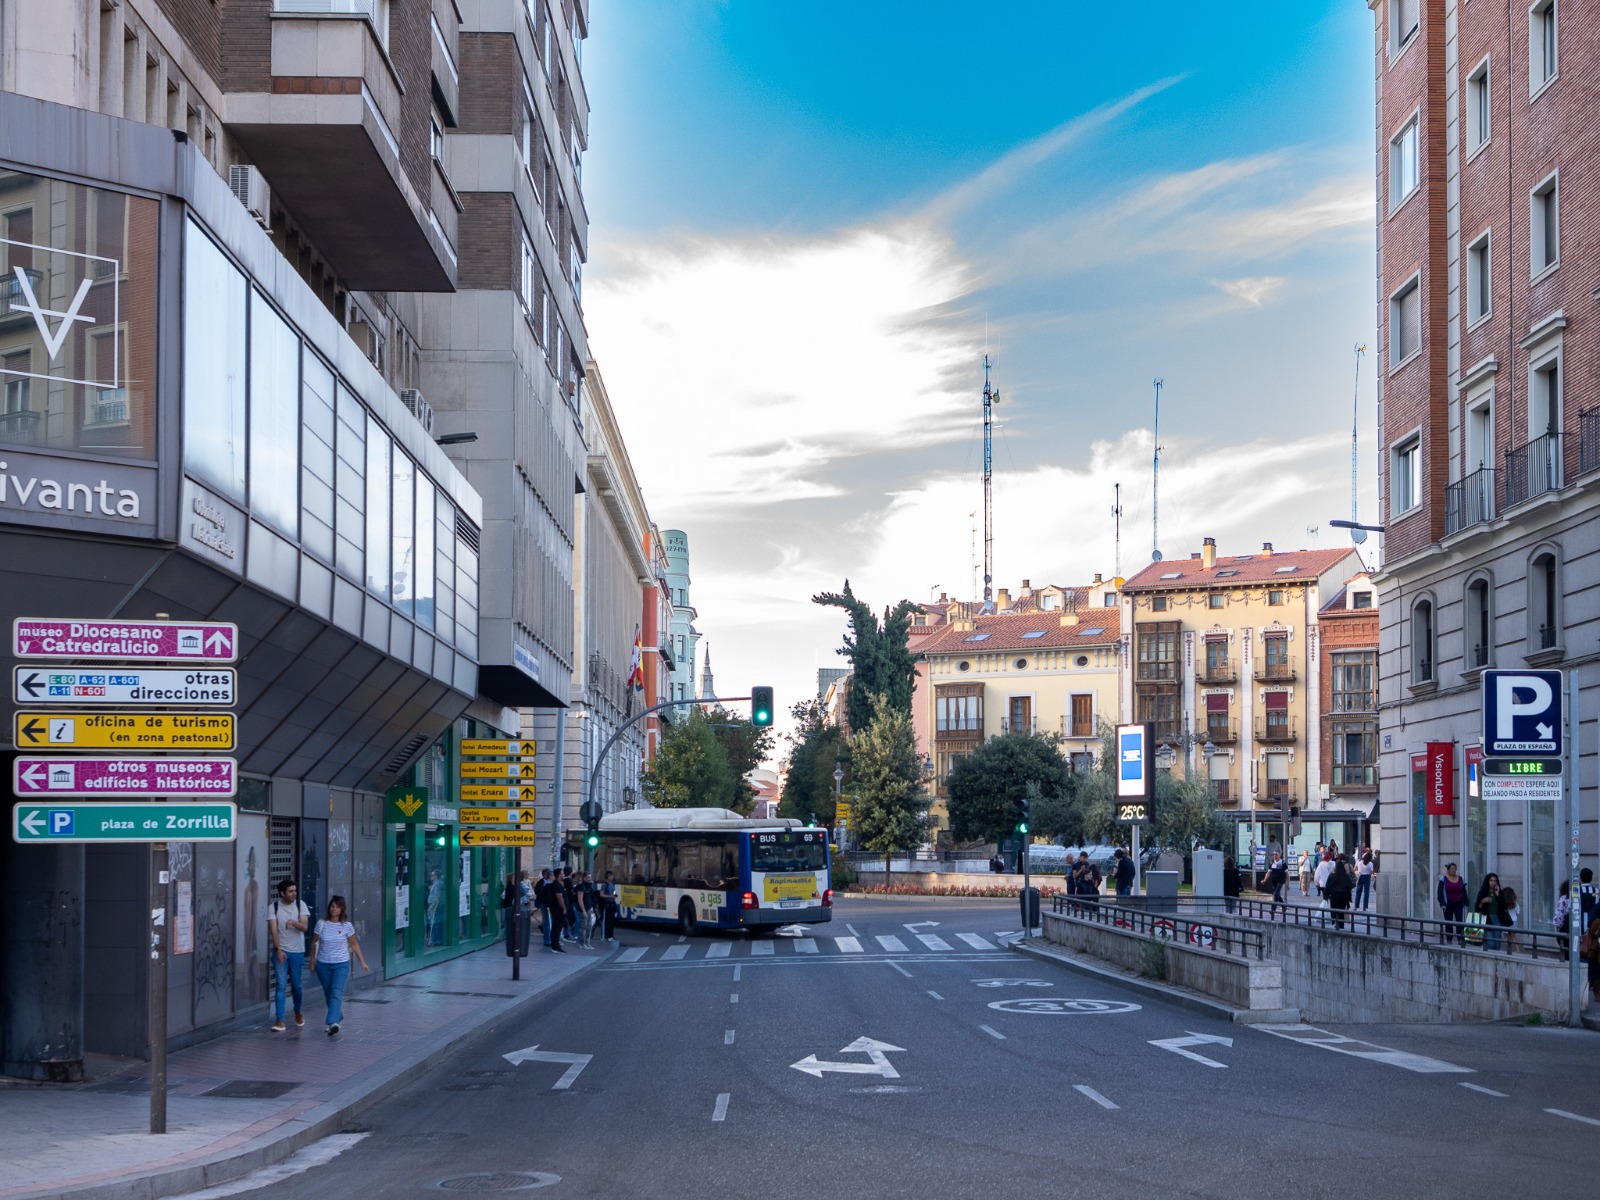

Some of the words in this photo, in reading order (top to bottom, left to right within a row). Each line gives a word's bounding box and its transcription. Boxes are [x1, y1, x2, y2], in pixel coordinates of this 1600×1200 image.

[20, 628, 63, 637] museo
[70, 624, 163, 639] Diocesano
[20, 640, 31, 653] y
[42, 638, 159, 654] Catredralicio
[49, 675, 75, 684] E-80
[80, 676, 105, 684] A-62
[110, 676, 139, 684] A-601
[185, 672, 230, 685] otras
[50, 687, 70, 695] A-11
[75, 687, 105, 695] N-601
[130, 686, 230, 700] direcciones
[1496, 675, 1553, 739] P
[85, 716, 135, 727] oficina
[145, 717, 163, 728] de
[172, 717, 229, 728] turismo
[109, 731, 130, 743] (en
[137, 733, 164, 742] zona
[172, 732, 229, 744] peatonal)
[108, 761, 147, 773] otros
[155, 762, 212, 773] museos
[221, 763, 230, 775] y
[1509, 763, 1543, 773] LIBRE
[157, 776, 230, 789] históricos
[53, 812, 71, 833] P
[101, 819, 135, 831] plaza
[142, 819, 158, 829] de
[166, 815, 230, 829] Zorrilla
[479, 834, 500, 842] otros
[503, 834, 533, 842] hoteles
[760, 834, 776, 843] BUS
[803, 834, 813, 842] 69
[700, 892, 705, 903] a
[707, 892, 722, 908] gas
[1018, 1001, 1110, 1011] 30
